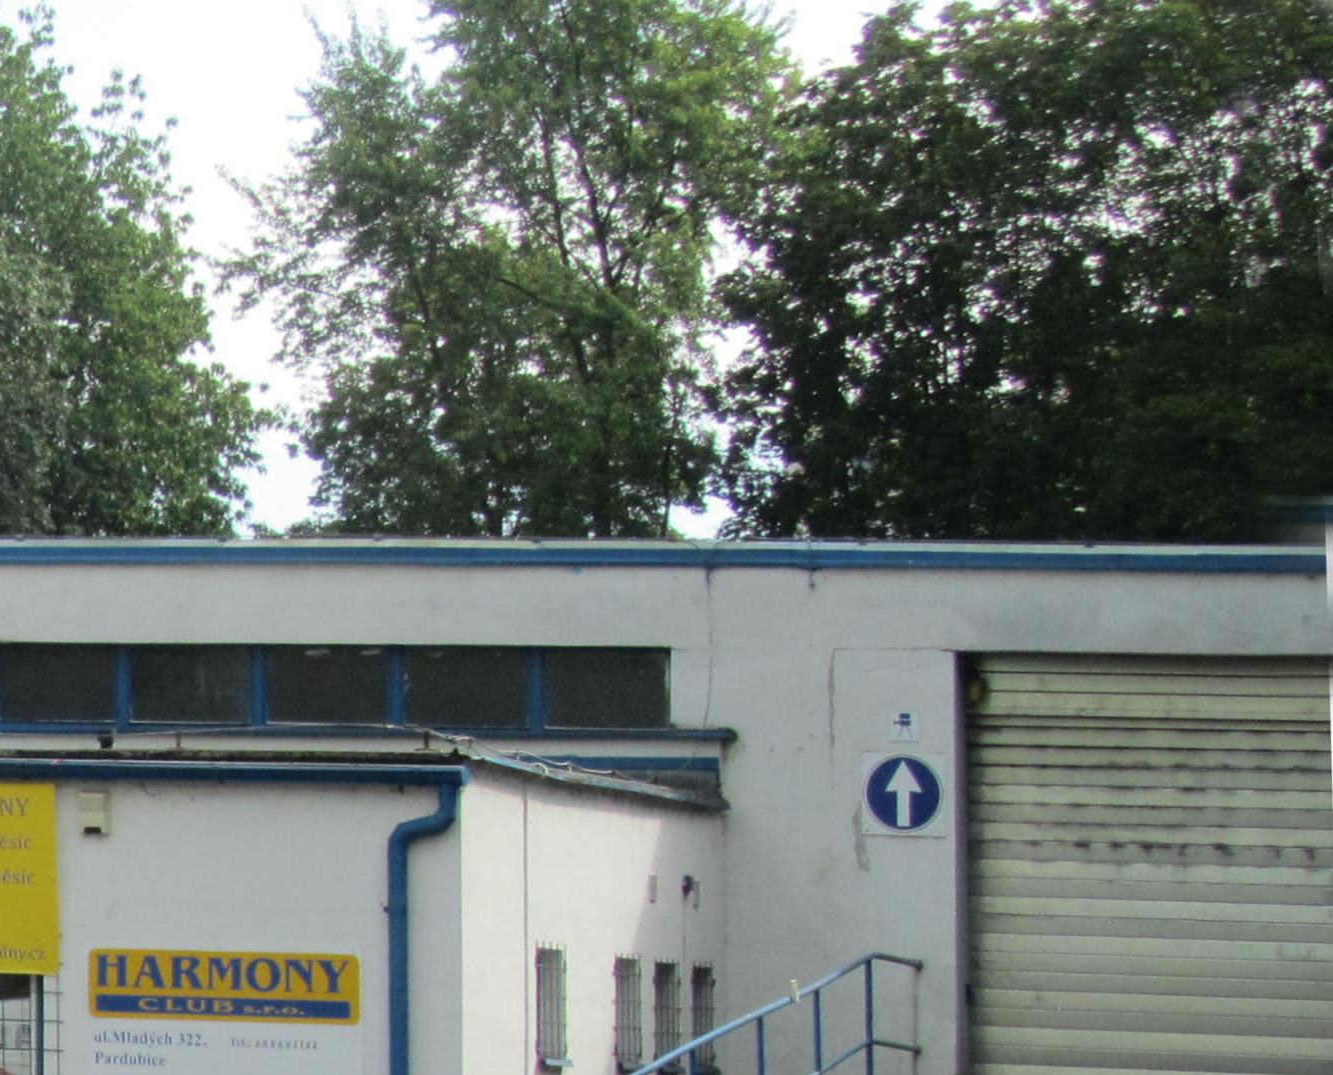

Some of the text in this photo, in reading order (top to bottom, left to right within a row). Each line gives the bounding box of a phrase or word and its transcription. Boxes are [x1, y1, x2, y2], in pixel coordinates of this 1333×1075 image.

[96, 954, 350, 994] HARMONY
[137, 997, 305, 1016] CLUB s.r.o.
[94, 1051, 167, 1067] Pardubice
